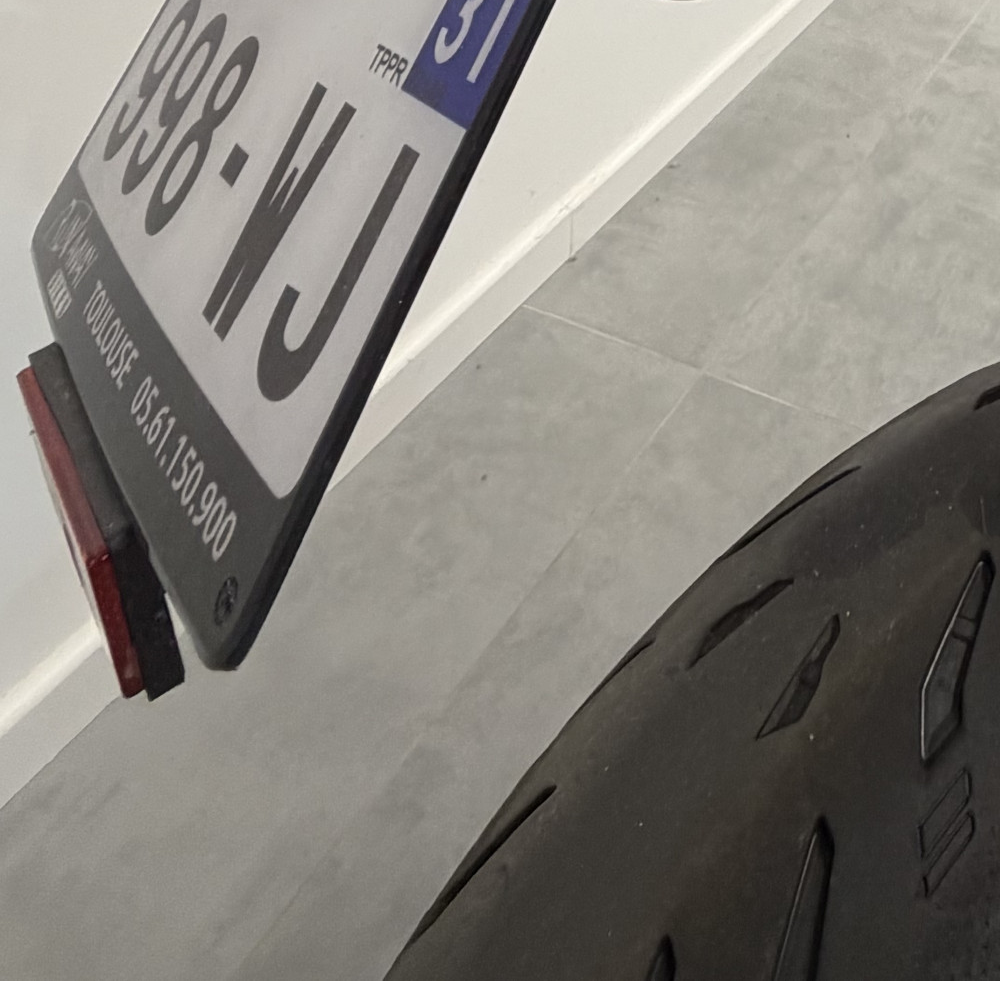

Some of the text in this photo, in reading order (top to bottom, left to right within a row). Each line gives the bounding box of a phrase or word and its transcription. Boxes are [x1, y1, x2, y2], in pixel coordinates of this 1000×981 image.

[369, 43, 408, 87] TPPR
[83, 279, 237, 562] TOULOUSE 05.61.150.900
